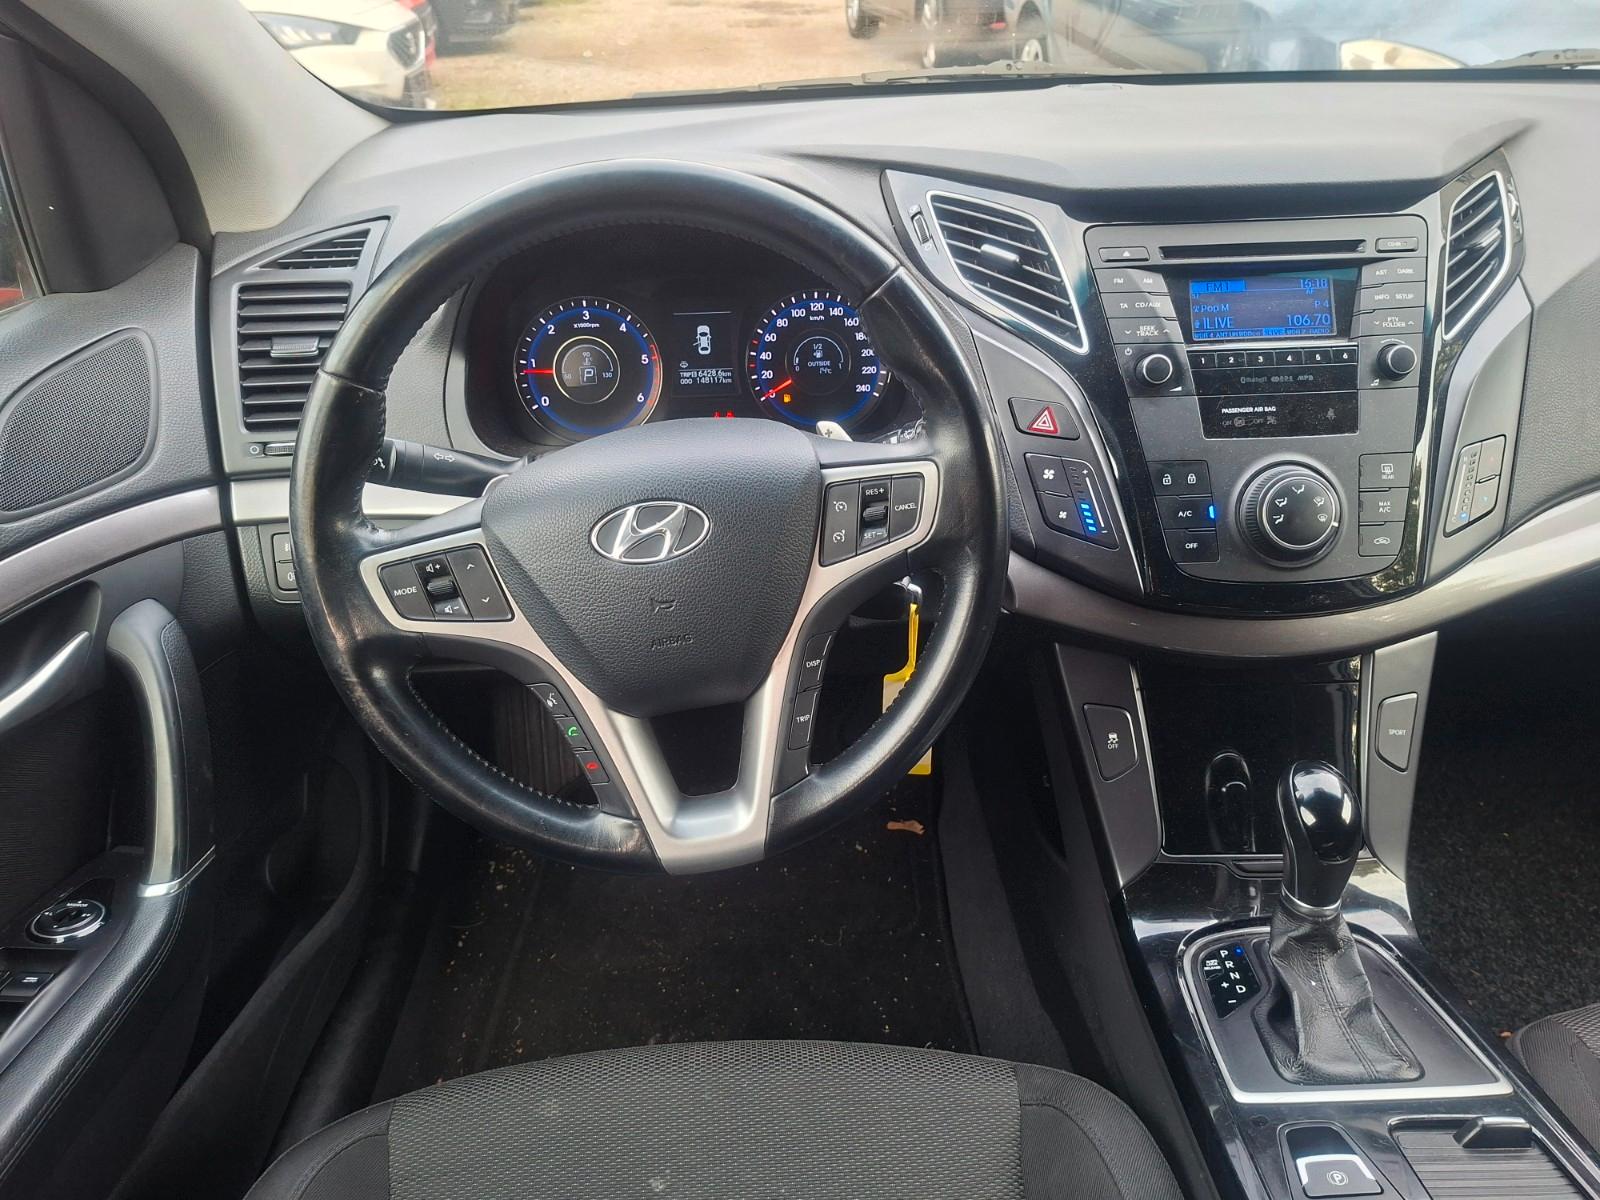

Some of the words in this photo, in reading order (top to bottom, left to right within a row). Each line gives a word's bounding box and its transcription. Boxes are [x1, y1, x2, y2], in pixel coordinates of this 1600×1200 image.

[810, 302, 824, 311] 120
[1200, 304, 1220, 312] Pop
[582, 311, 590, 320] 3
[791, 309, 806, 317] 100
[830, 307, 844, 316] 140
[776, 318, 788, 327] 80
[844, 318, 859, 326] 160
[1287, 314, 1330, 326] 106.70
[548, 324, 556, 334] 2
[619, 324, 627, 332] 4
[764, 332, 776, 342] 60
[641, 354, 649, 364] 5
[760, 352, 772, 360] 40
[530, 359, 536, 368] 1
[761, 370, 773, 379] 20
[862, 366, 876, 374] 220
[584, 368, 594, 382] P
[856, 384, 870, 392] 240
[541, 396, 550, 406] 0
[636, 393, 644, 402] 6
[894, 502, 917, 512] CANCEL
[394, 586, 418, 596] MODE
[806, 659, 820, 668] DISP
[796, 714, 810, 724] TRIP
[1220, 950, 1228, 958] P
[1224, 960, 1234, 968] R
[1230, 972, 1240, 980] N
[1236, 985, 1246, 993] D
